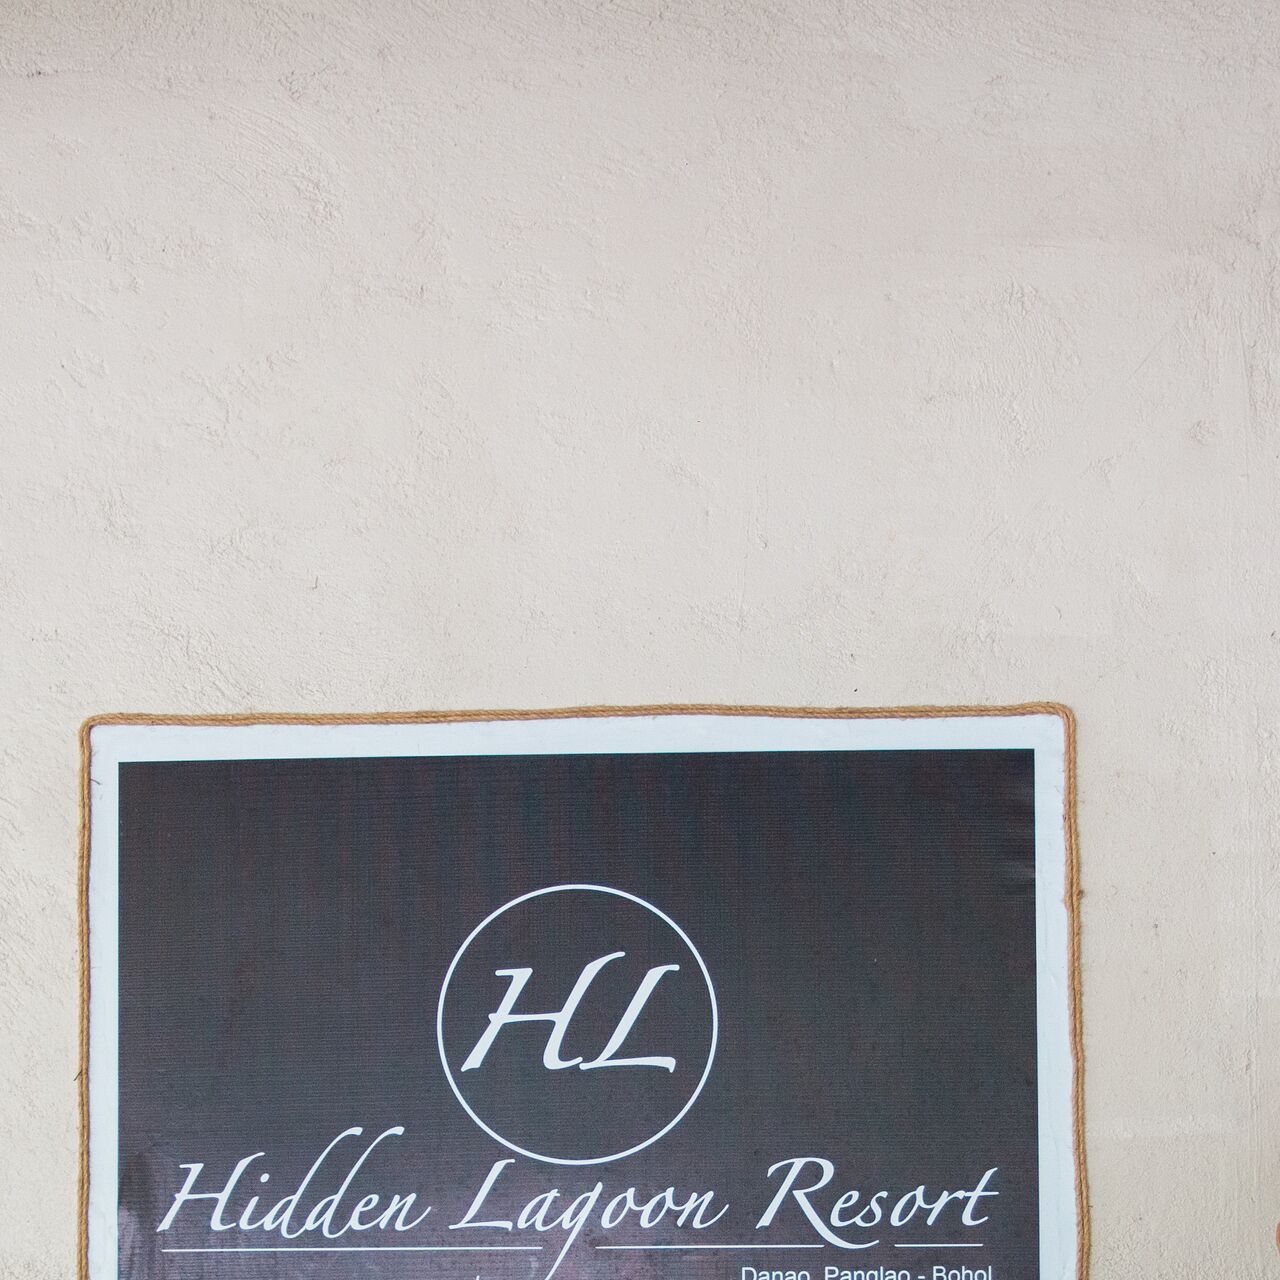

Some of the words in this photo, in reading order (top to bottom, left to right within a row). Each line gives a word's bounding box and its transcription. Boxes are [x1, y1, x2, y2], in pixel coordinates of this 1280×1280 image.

[461, 951, 680, 1073] HL
[156, 1126, 431, 1240] Hidden
[755, 1156, 999, 1250] Resort
